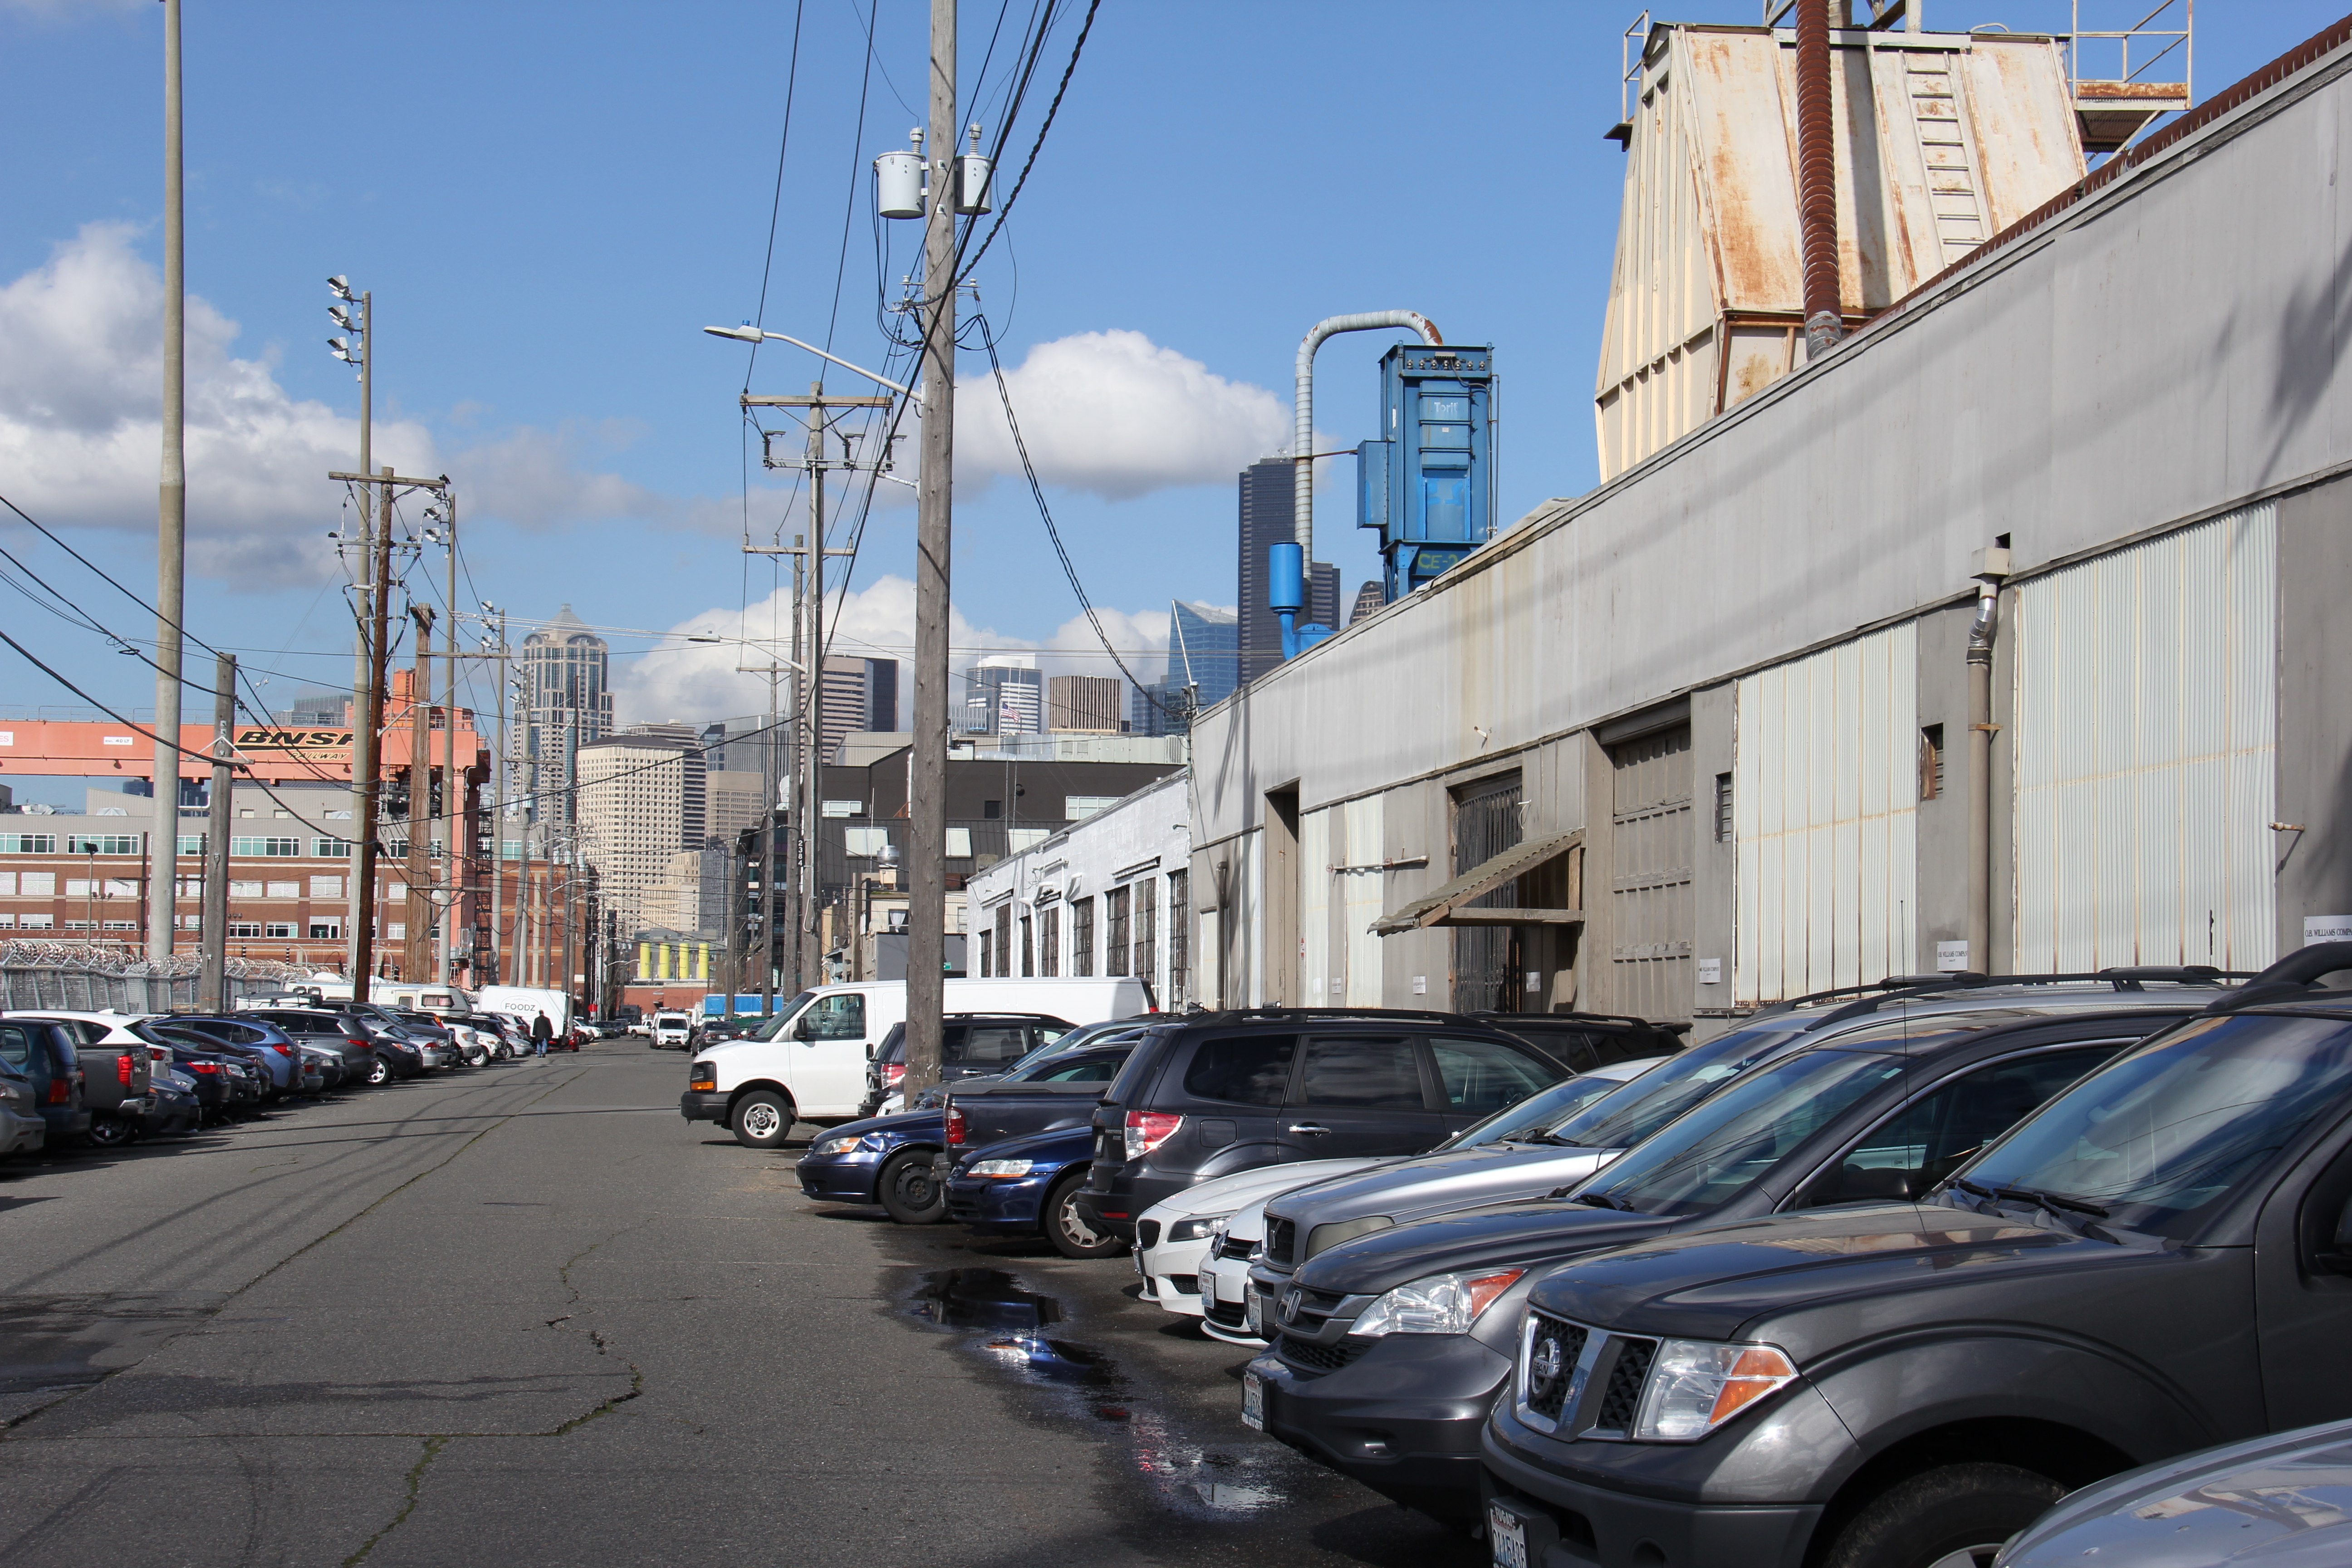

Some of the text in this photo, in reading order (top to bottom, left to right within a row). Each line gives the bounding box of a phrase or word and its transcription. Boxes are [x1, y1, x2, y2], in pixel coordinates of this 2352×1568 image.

[289, 752, 350, 760] RAILWAY
[2314, 928, 2336, 936] WILLIAMS
[505, 1003, 536, 1011] FOODZ
